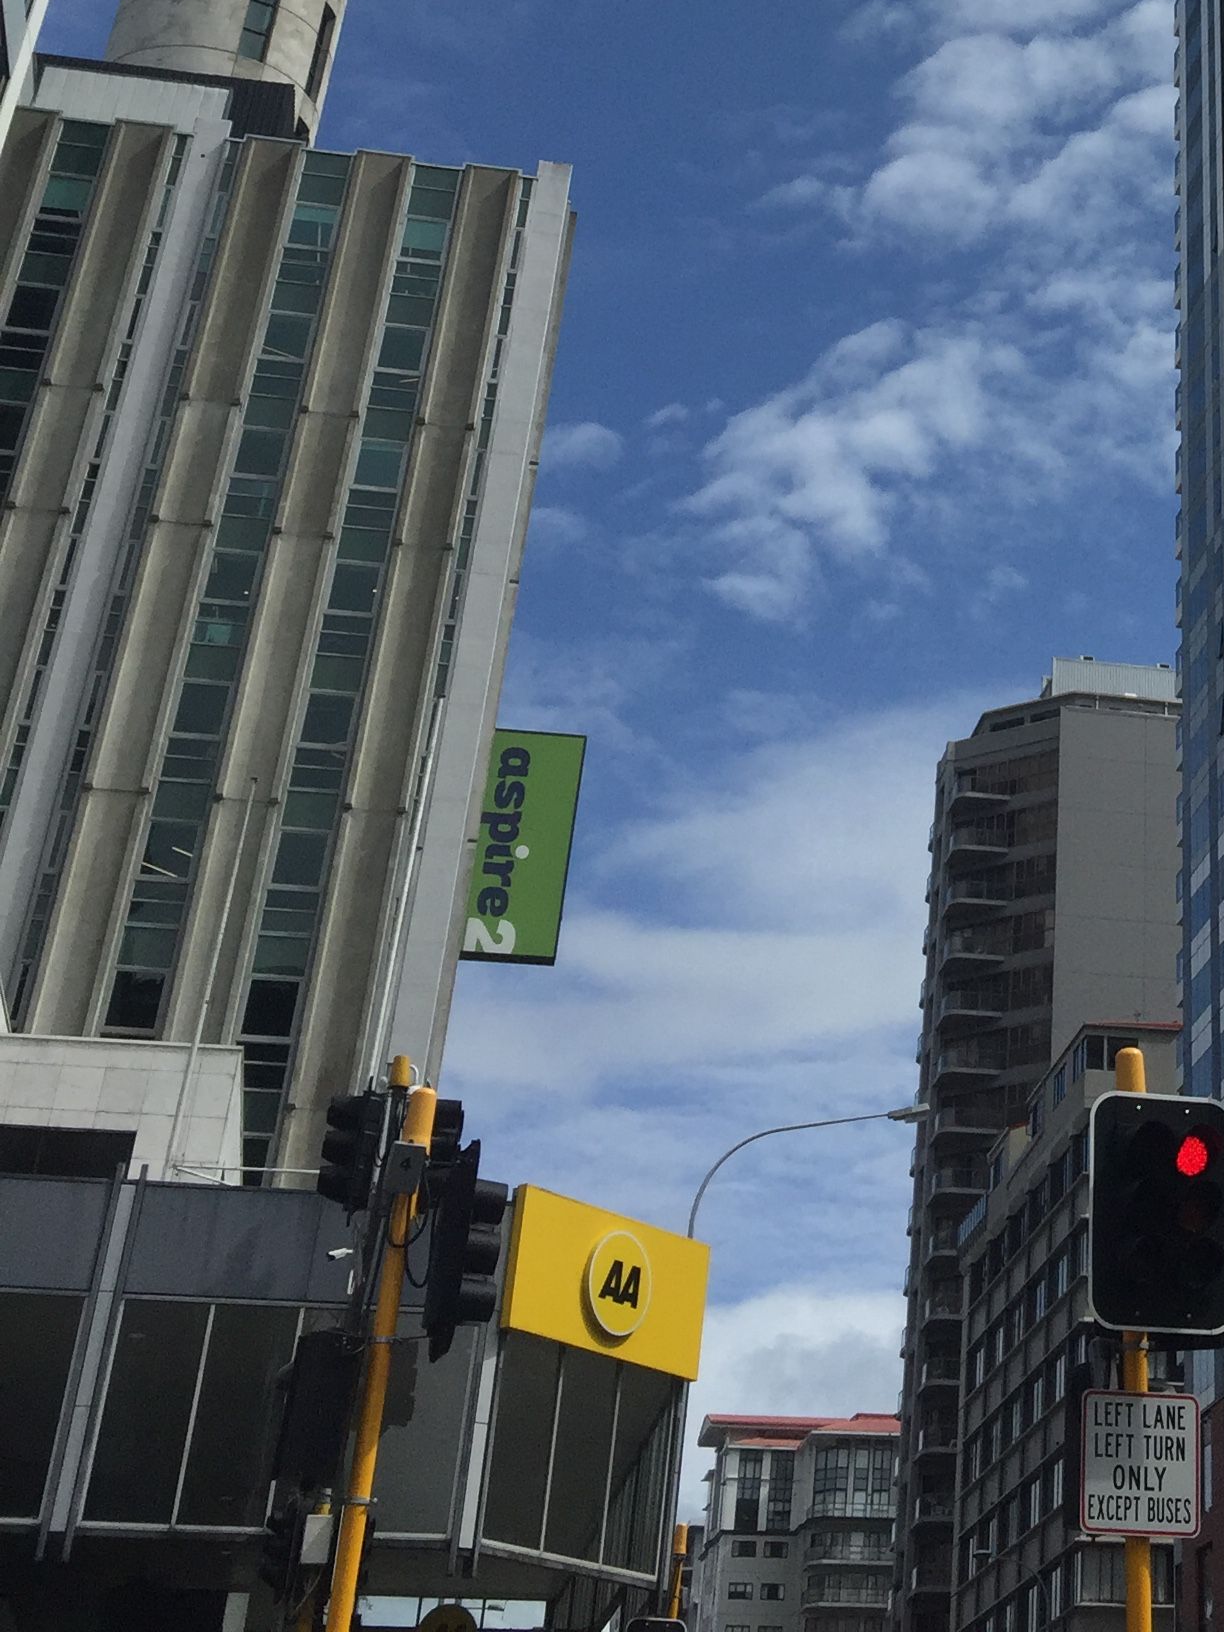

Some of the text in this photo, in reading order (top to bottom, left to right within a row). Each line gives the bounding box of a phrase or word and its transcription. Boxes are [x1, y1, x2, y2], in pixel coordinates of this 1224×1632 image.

[463, 747, 532, 954] aspire2
[400, 1156, 412, 1171] 4
[597, 1259, 642, 1310] AA
[1094, 1401, 1186, 1431] LEFT LANE
[1094, 1432, 1186, 1462] LEFT TURN
[1112, 1464, 1167, 1492] ONLY
[1087, 1494, 1192, 1524] EXCEPT BUSES
